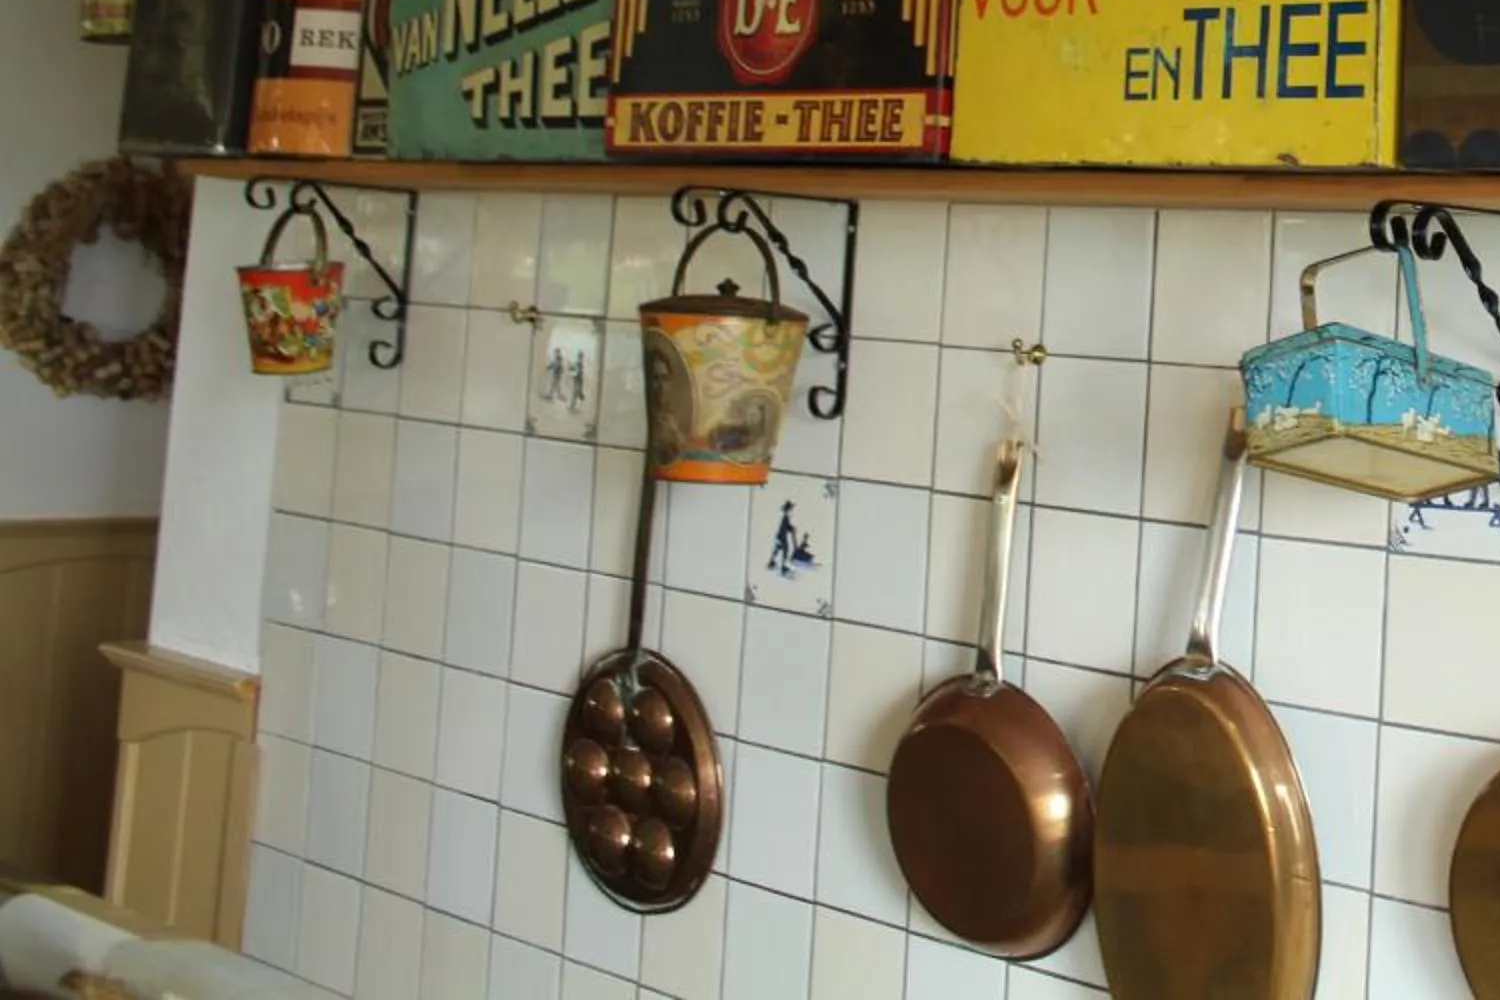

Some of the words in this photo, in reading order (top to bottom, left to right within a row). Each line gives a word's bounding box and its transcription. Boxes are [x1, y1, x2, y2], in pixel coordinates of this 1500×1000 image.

[391, 10, 439, 76] VAN
[461, 20, 611, 129] THEE
[1124, 47, 1181, 101] EN
[1184, 1, 1368, 100] THEE
[629, 100, 765, 143] KOFFIE
[794, 99, 904, 143] THEE
